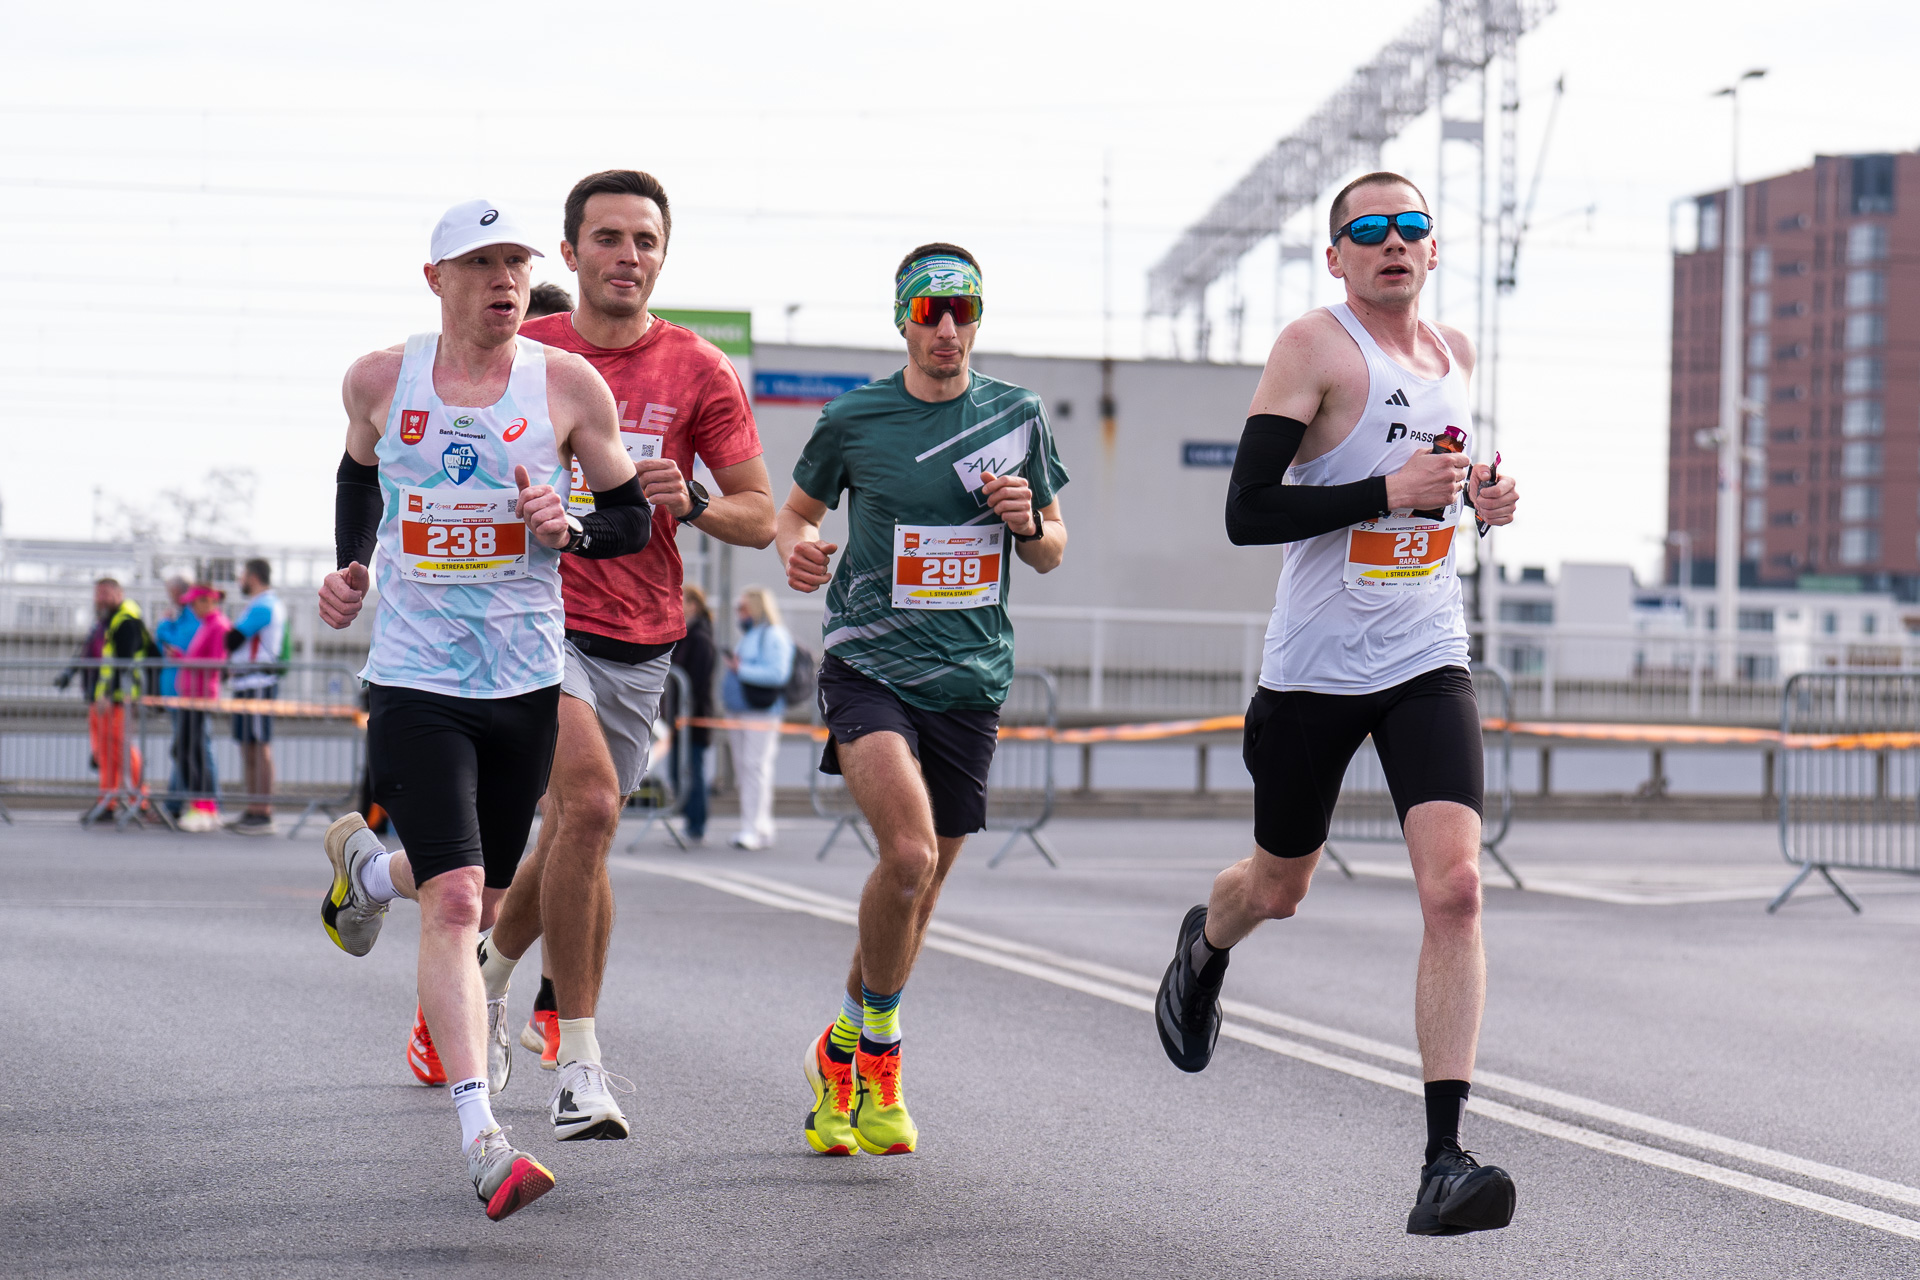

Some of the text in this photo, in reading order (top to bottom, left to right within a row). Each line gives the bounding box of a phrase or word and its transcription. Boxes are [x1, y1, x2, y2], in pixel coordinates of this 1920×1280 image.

[614, 400, 678, 432] LE
[454, 430, 486, 440] Piastowski
[1410, 430, 1436, 444] PASSI
[446, 456, 472, 466] UNIA
[427, 526, 496, 556] 238
[1393, 532, 1429, 558] 23
[904, 548, 918, 557] 56
[922, 558, 981, 584] 299
